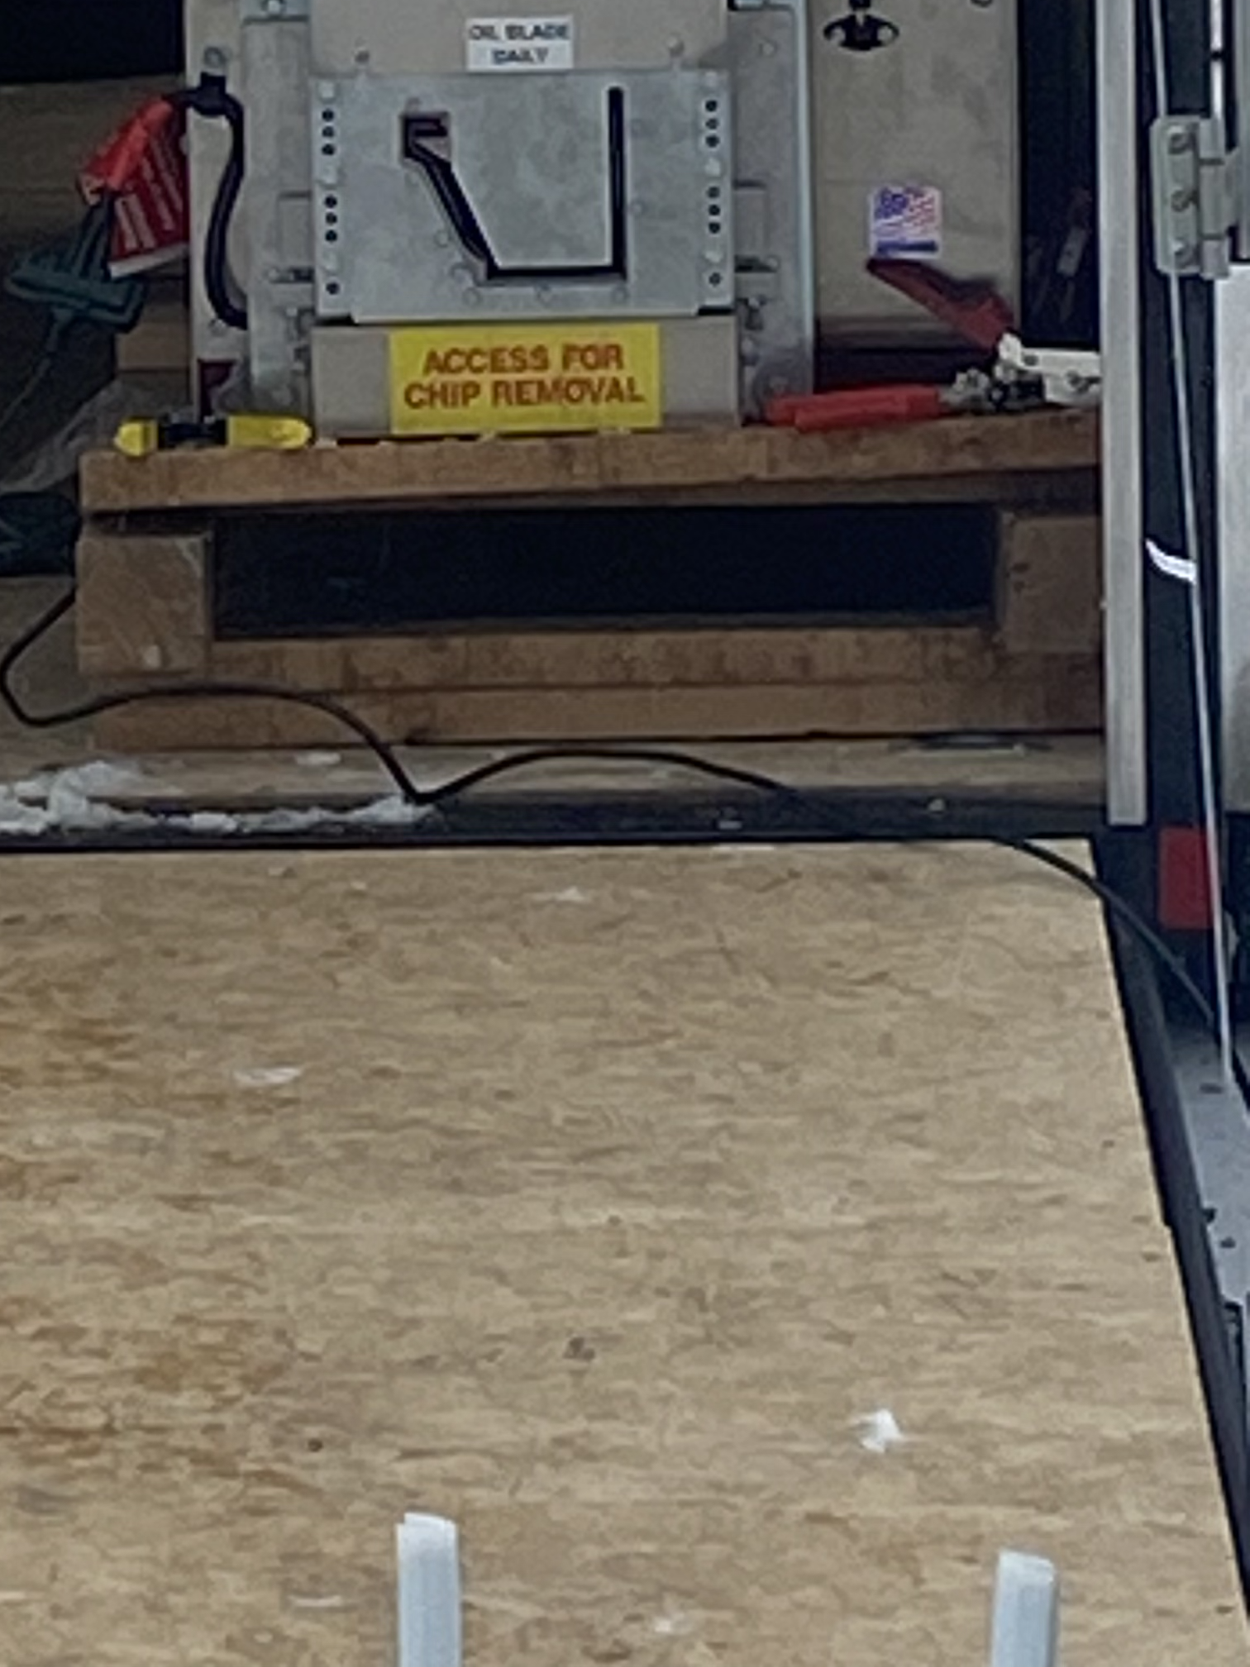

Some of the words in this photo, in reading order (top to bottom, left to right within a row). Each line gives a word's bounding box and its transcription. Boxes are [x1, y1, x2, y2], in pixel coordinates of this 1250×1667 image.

[469, 24, 499, 40] OIL
[505, 24, 569, 40] BLADE
[492, 47, 548, 65] DAILY
[423, 345, 548, 375] ACCESS
[561, 343, 623, 370] FOR
[404, 381, 481, 409] CHIP
[491, 377, 646, 407] REMOVAL
